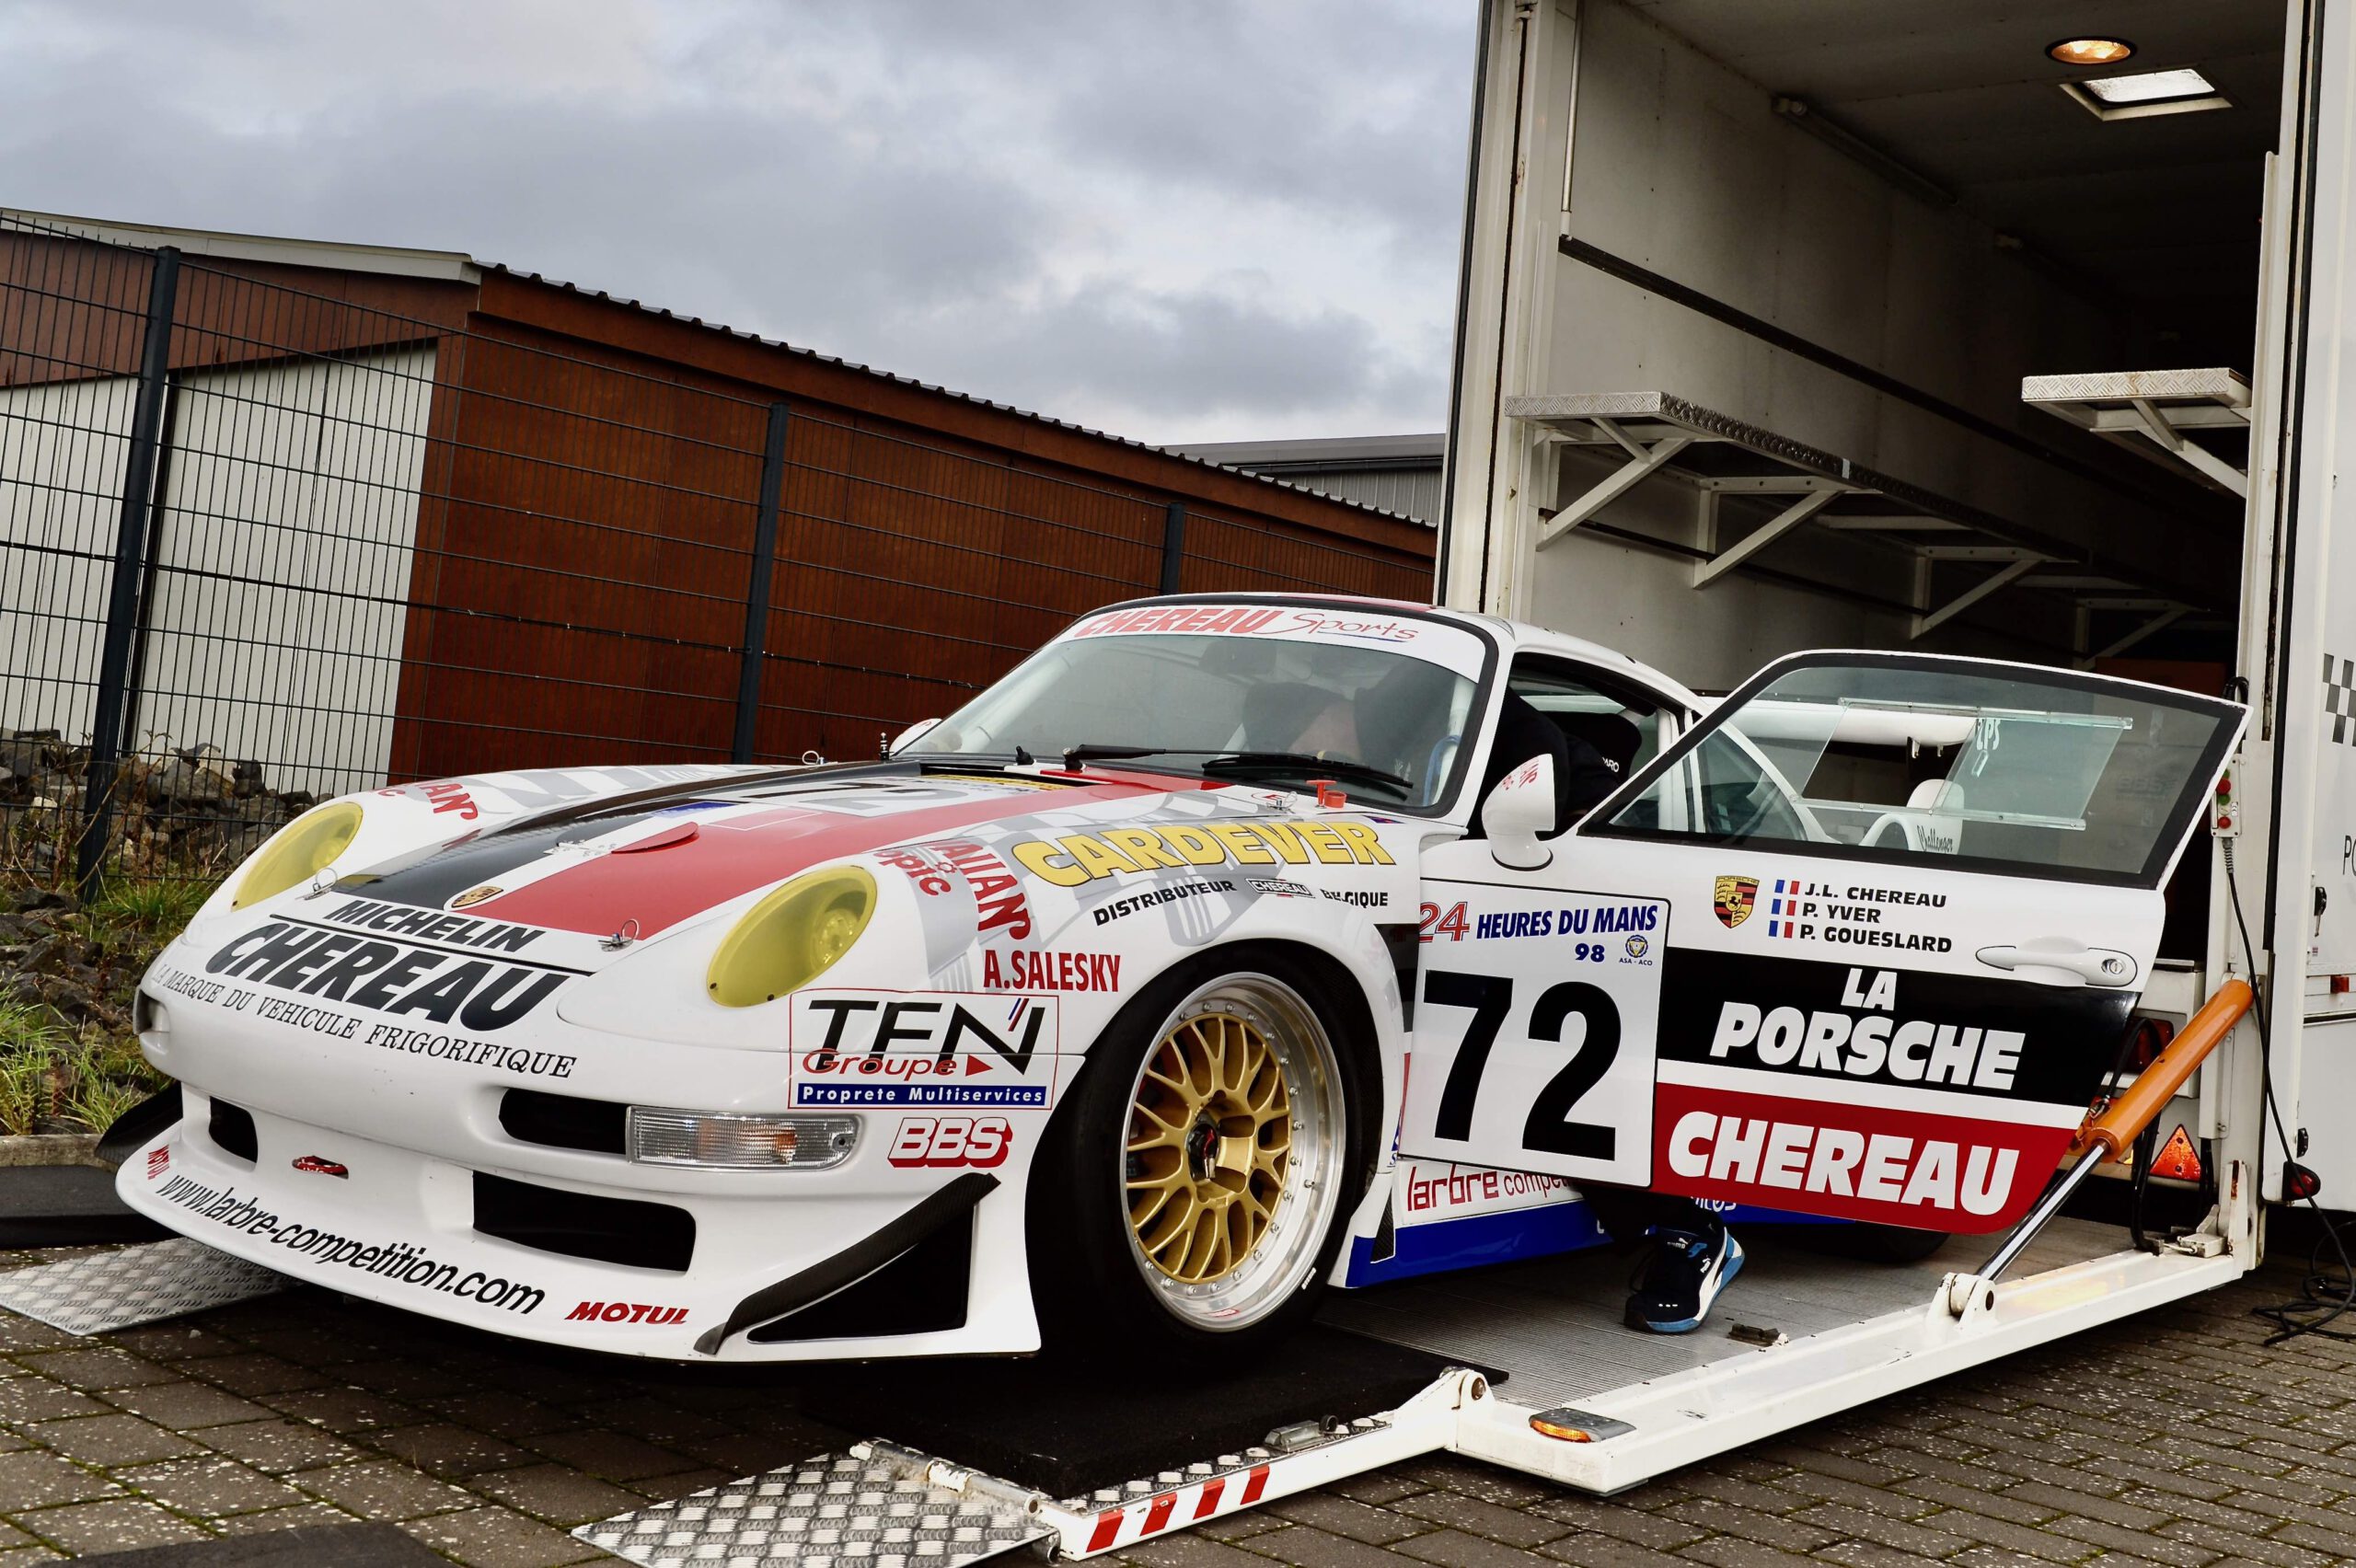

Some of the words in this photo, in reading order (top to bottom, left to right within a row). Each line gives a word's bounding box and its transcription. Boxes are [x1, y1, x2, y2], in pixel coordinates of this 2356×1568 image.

[1074, 608, 1285, 638] CHEREAU
[1252, 612, 1418, 640] Sports
[1012, 821, 1397, 888] CARDEVER
[1093, 880, 1237, 927] DISTRIBUTEUR
[1252, 881, 1310, 896] CHEREAU
[1802, 902, 1819, 917] P.
[1827, 904, 1881, 924] YVER
[1805, 882, 1839, 898] J.L.
[1846, 886, 1946, 908] CHEREAU
[322, 899, 547, 952] MICHELIN
[1419, 901, 1470, 943] 24
[1476, 910, 1553, 940] HEURES
[1557, 908, 1588, 935] DU
[1592, 905, 1658, 933] MANS
[1799, 924, 1816, 940] P.
[1824, 926, 1952, 953] GOUESLARD
[983, 950, 1121, 992] A.SALESKY
[1575, 943, 1605, 963] 98
[205, 922, 571, 1032] CHEREAU
[1841, 967, 1898, 1011] LA
[152, 963, 169, 983] LA
[163, 968, 225, 1004] MARQUE
[222, 988, 258, 1010] DU
[256, 997, 363, 1040] VEHICULE
[364, 1023, 578, 1078] FRIGORIFIQUE
[808, 997, 1045, 1076] TFN
[803, 1047, 956, 1081] Groupe
[1424, 969, 1621, 1161] 72
[1709, 1000, 2027, 1090] PORSCHE
[803, 1086, 896, 1102] Proprete
[908, 1087, 1043, 1102] Multiservices
[887, 1116, 1013, 1169] BBS
[1669, 1111, 2020, 1216] CHEREAU
[1407, 1163, 1500, 1212] larbre
[156, 1174, 546, 1315] www.larbre-competition.com
[564, 1301, 691, 1326] MOTUL
